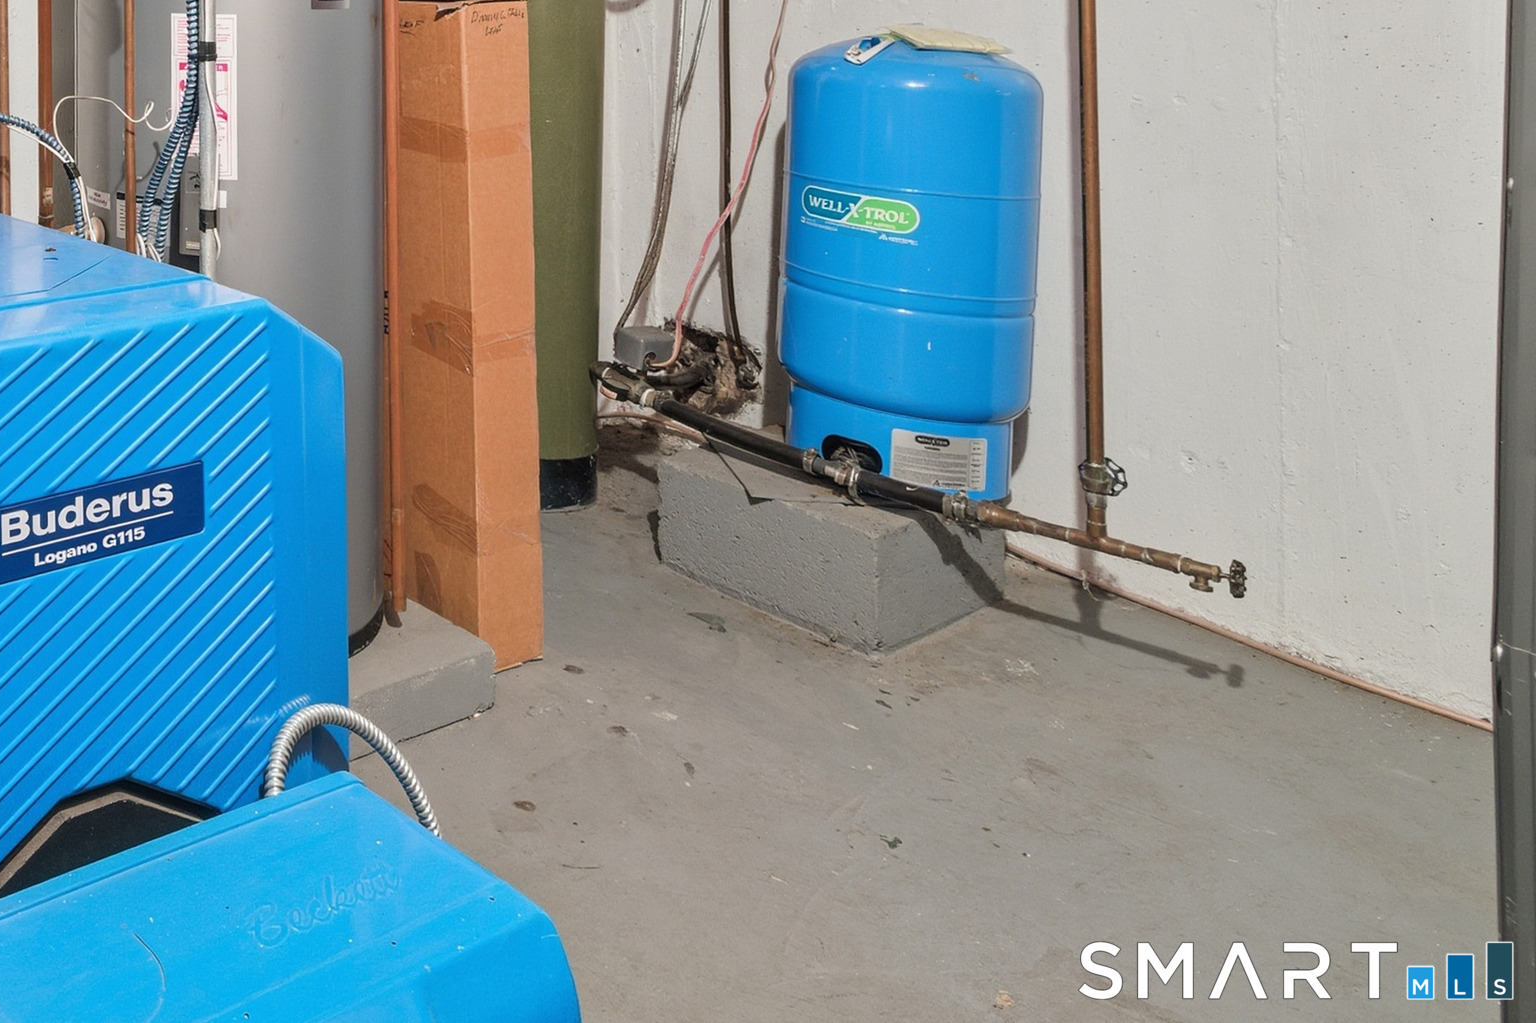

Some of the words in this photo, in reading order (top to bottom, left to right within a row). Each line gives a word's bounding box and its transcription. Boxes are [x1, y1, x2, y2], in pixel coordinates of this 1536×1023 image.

[1, 482, 174, 546] Buderus
[34, 542, 97, 567] Logano
[102, 526, 146, 549] G115
